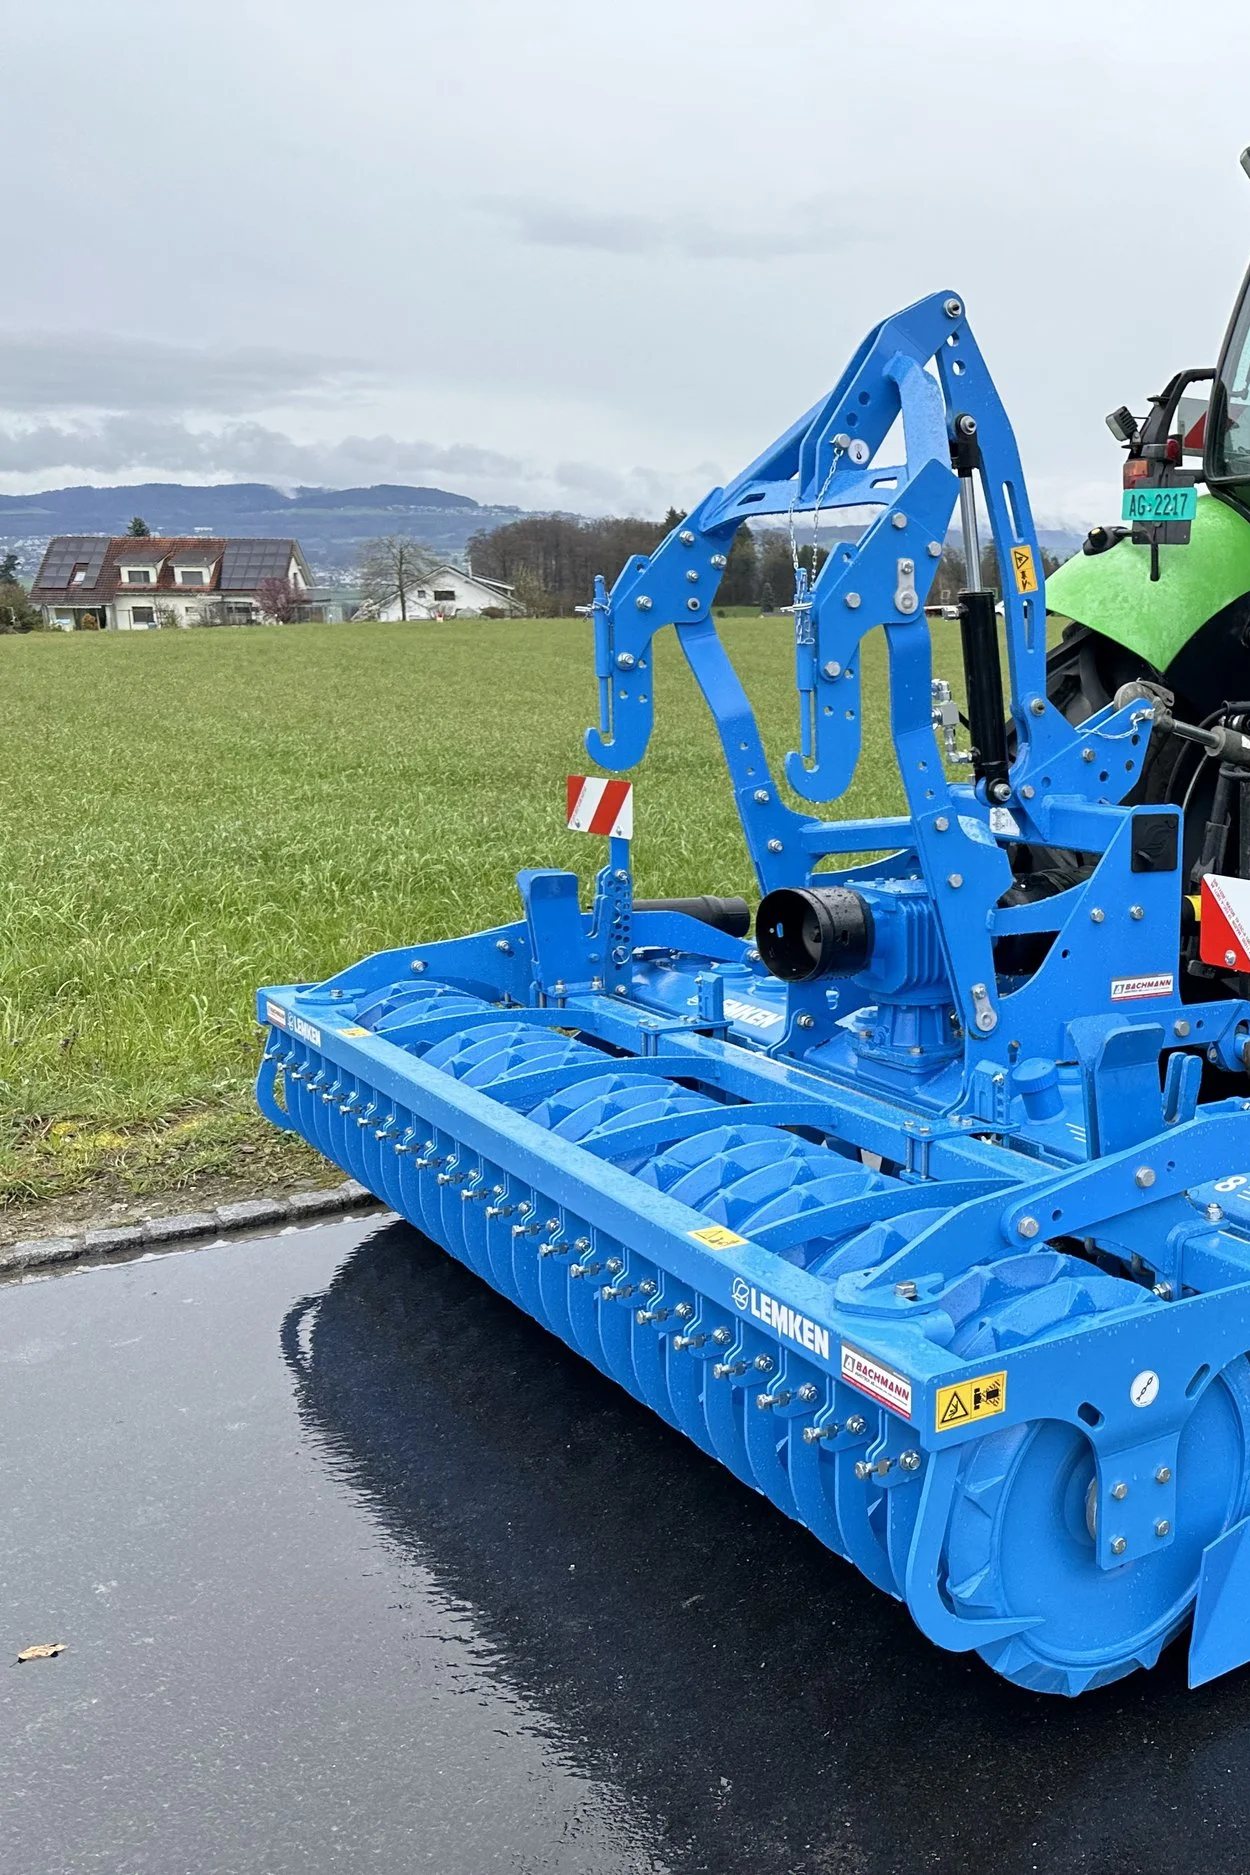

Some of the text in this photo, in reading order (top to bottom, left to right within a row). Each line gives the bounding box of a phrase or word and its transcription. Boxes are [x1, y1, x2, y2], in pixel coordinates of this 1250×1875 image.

[1125, 979, 1171, 990] BACHMANN
[723, 998, 785, 1029] EMKEN
[751, 1287, 829, 1361] LEMKEN
[856, 1361, 910, 1401] BACHMANN
